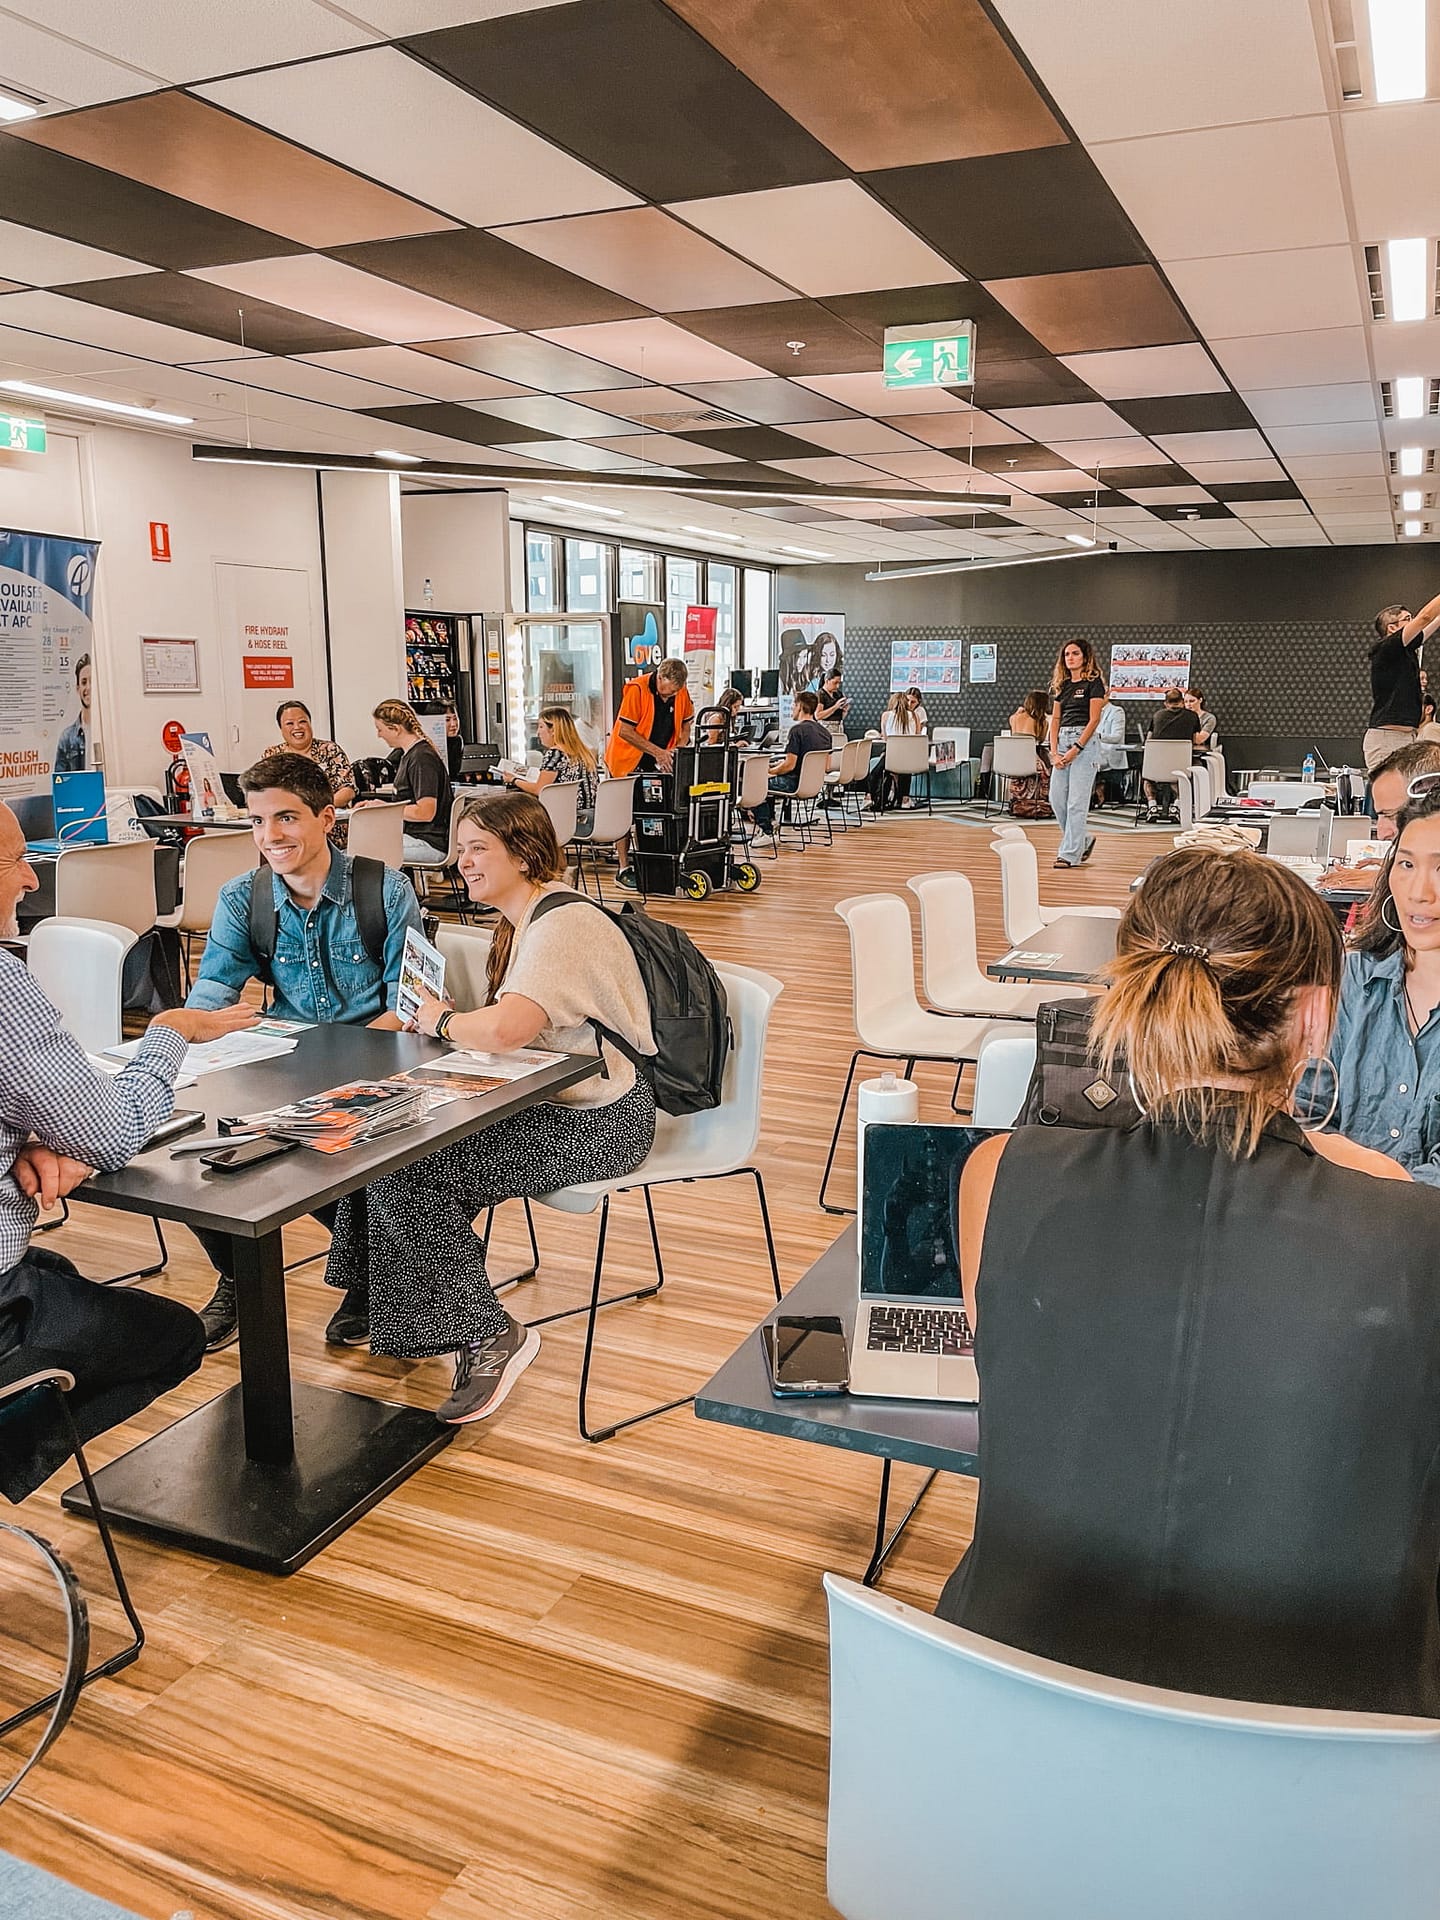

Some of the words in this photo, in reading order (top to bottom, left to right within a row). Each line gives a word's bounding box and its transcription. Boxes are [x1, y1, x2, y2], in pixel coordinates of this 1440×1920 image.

[0, 599, 48, 614] VAILABLE
[0, 614, 9, 627] T
[12, 615, 32, 628] APC
[245, 625, 259, 635] FIRE
[260, 626, 288, 636] HYDRANT
[254, 640, 271, 649] HOSE
[624, 637, 661, 665] Love
[60, 657, 69, 666] 15
